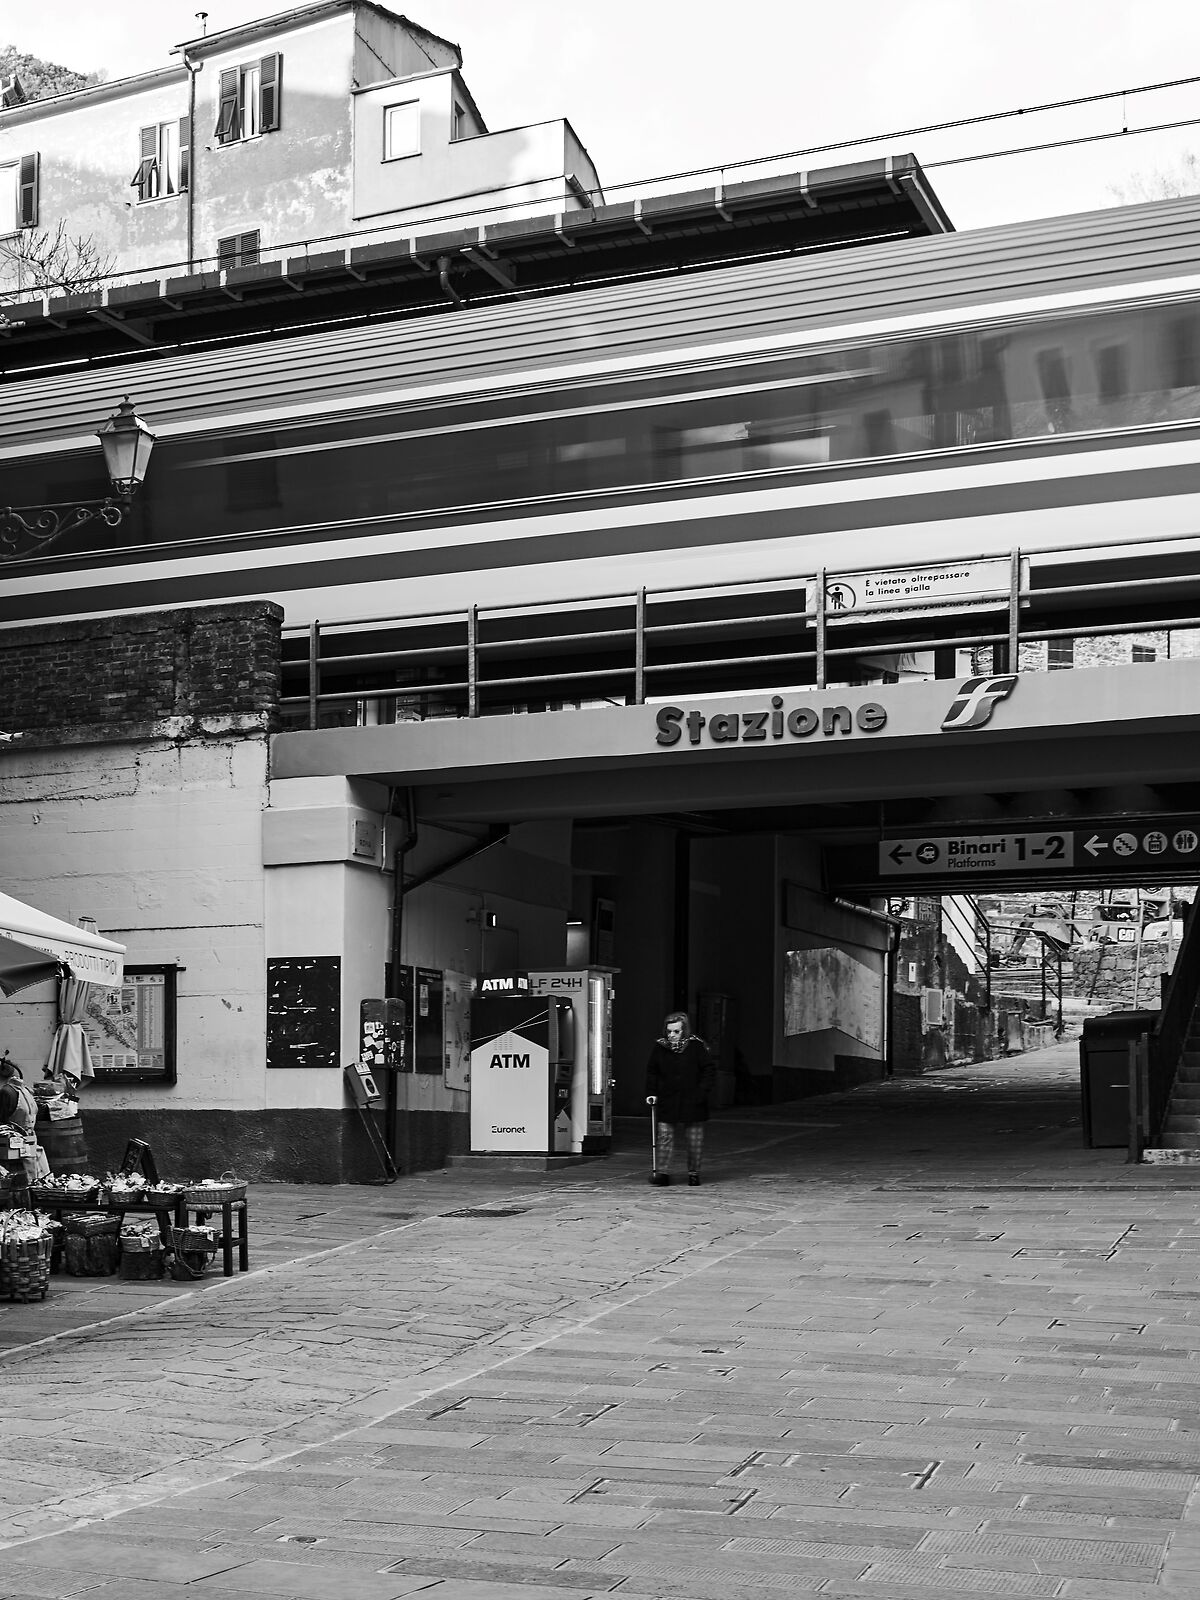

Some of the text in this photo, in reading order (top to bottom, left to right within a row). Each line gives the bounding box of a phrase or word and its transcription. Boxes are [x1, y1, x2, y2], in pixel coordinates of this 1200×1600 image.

[875, 578, 907, 586] vietato
[911, 572, 970, 582] oltrepassare
[878, 587, 901, 595] linea
[904, 584, 931, 594] gialla
[656, 695, 888, 746] Stazione
[948, 835, 1065, 861] Binari 1-2
[947, 857, 996, 868] Platforms
[482, 978, 514, 991] ATM
[551, 978, 582, 989] 24H
[490, 1053, 530, 1068] ATM
[491, 1125, 526, 1134] Euronet
